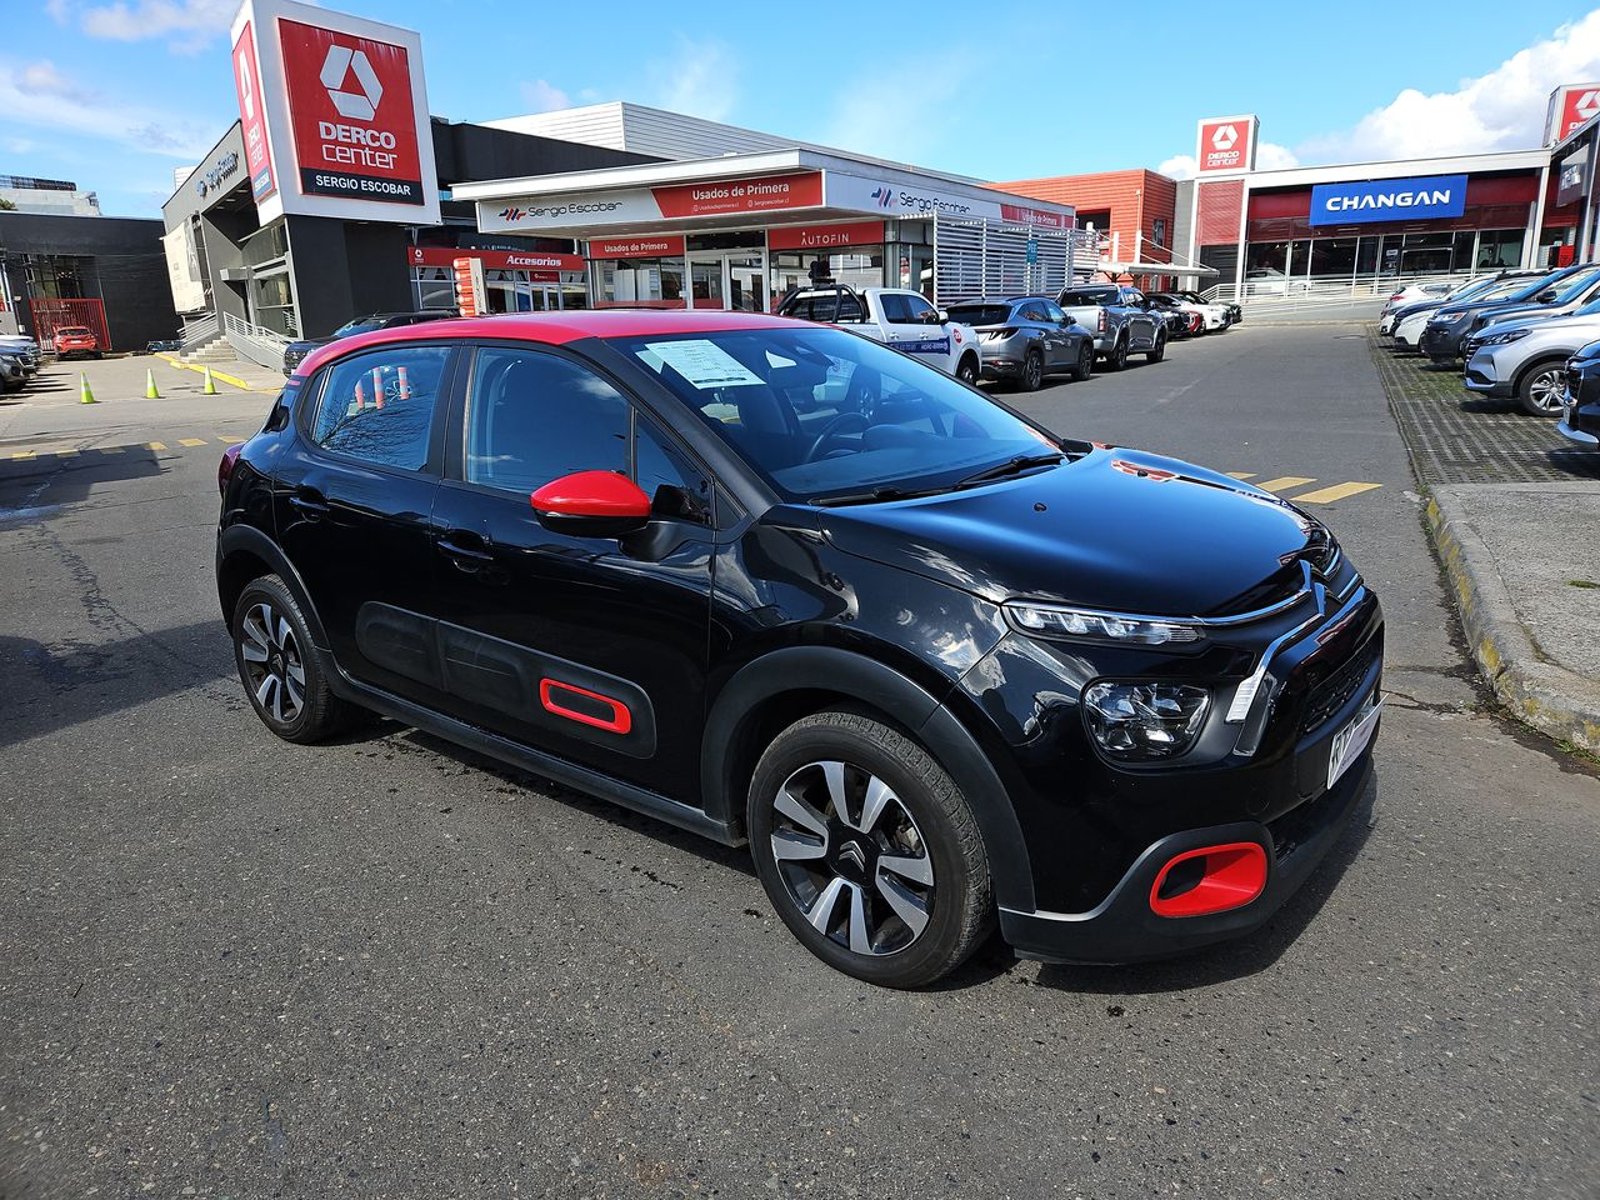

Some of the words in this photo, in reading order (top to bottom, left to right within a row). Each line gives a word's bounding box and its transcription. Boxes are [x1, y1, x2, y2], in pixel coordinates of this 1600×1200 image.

[318, 121, 396, 150] DERCO
[322, 144, 398, 169] center
[1207, 151, 1240, 160] DERCO
[315, 175, 359, 190] SERGIO
[360, 180, 411, 195] ESCOBAR
[692, 188, 729, 201] Usados
[731, 186, 744, 197] de
[747, 183, 790, 195] Primera
[568, 202, 622, 213] Escobar
[1326, 190, 1451, 211] CHANGAN
[604, 244, 630, 252] Usados
[630, 243, 640, 251] de
[640, 242, 669, 251] Primera
[506, 255, 562, 267] Accesorios
